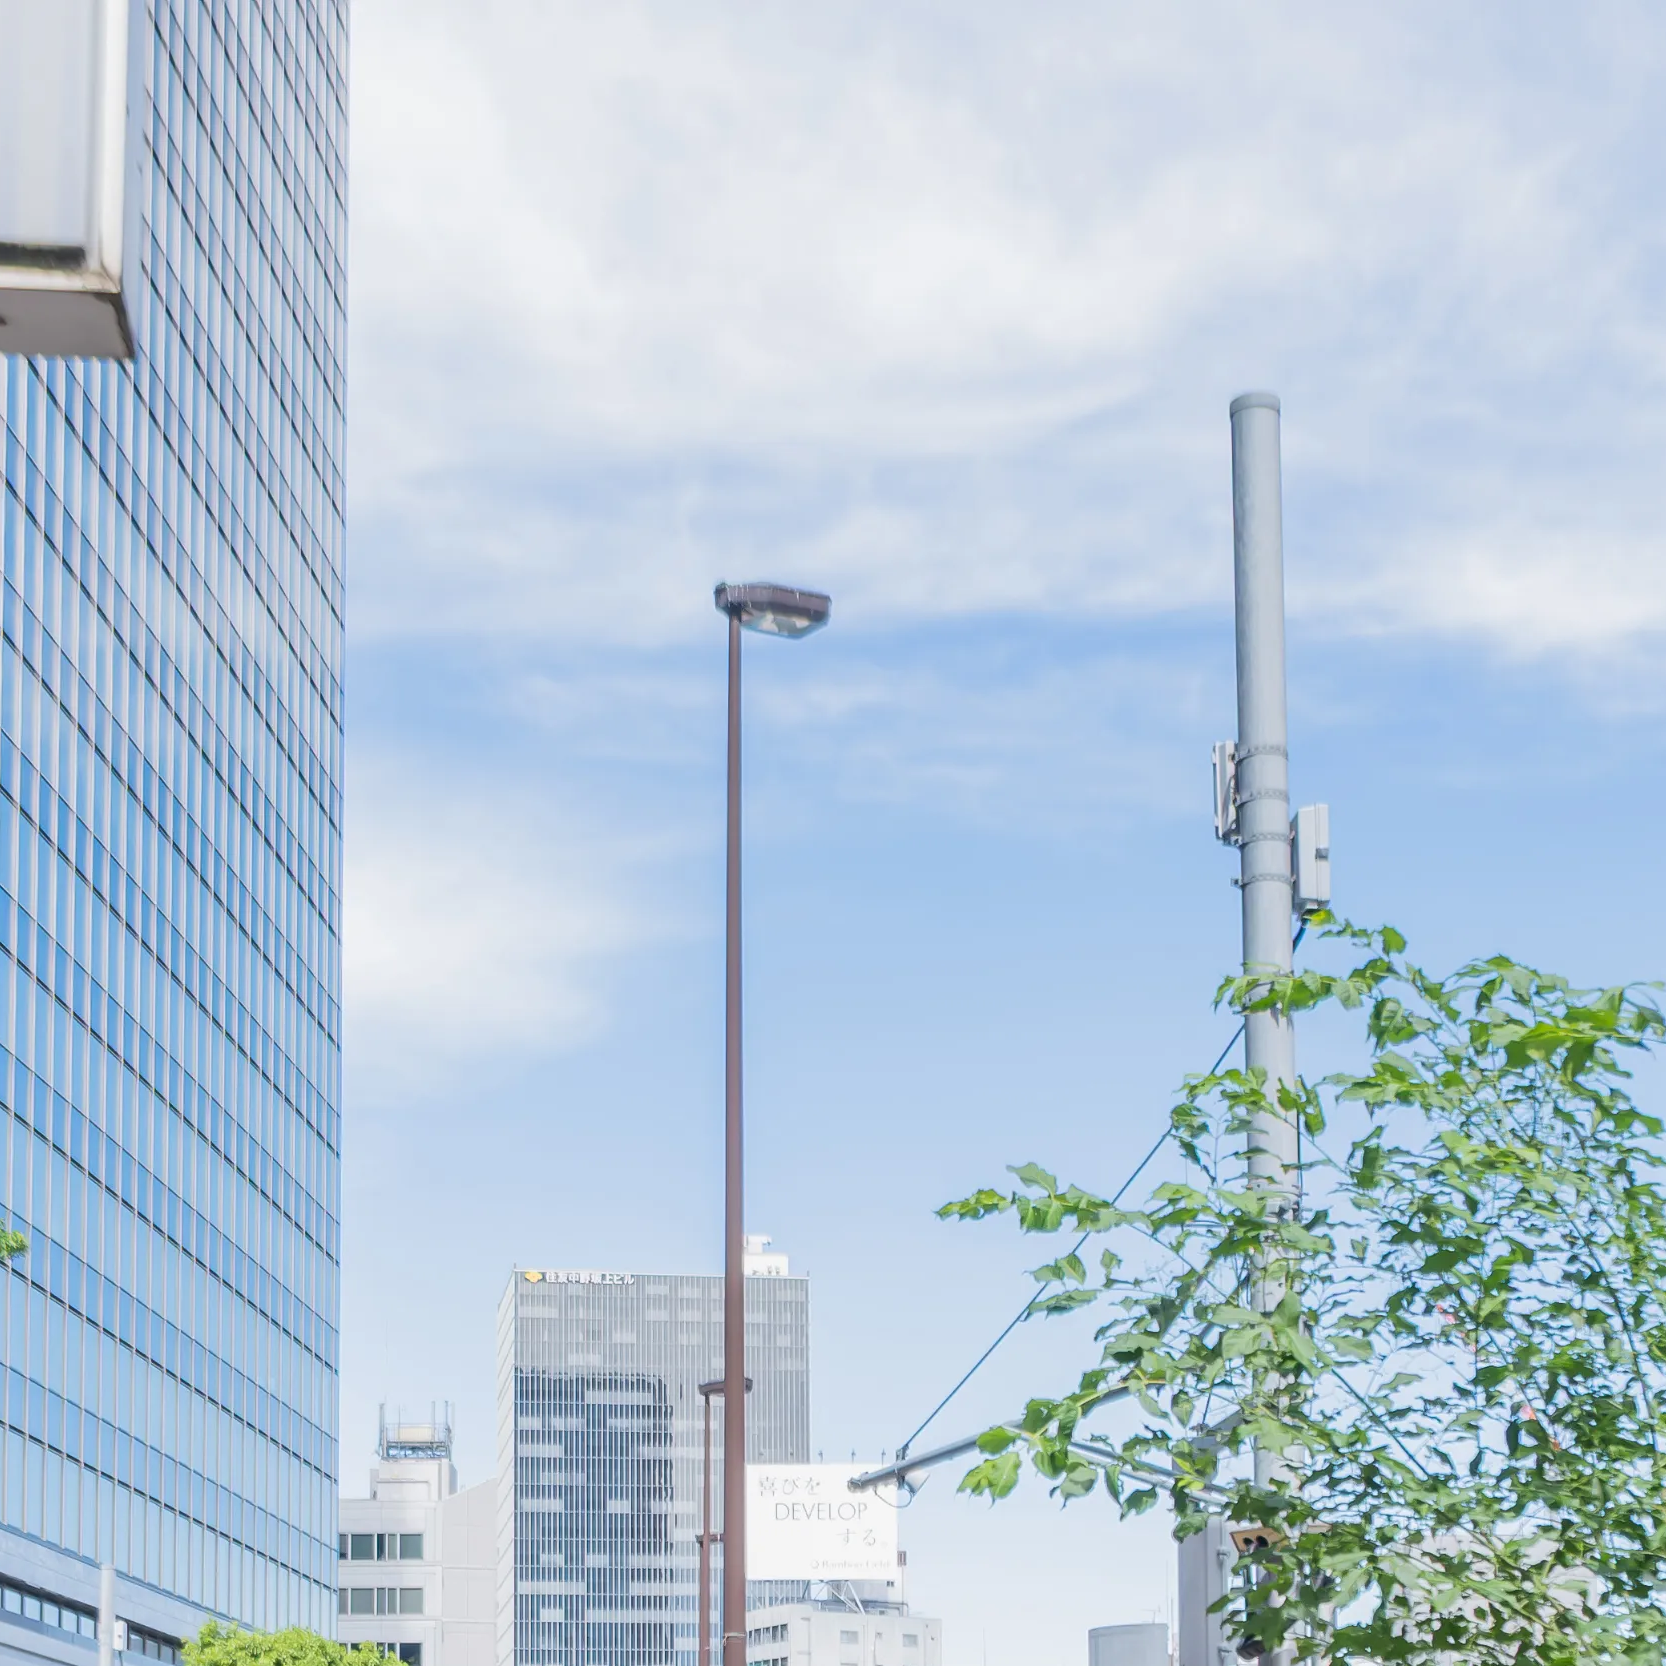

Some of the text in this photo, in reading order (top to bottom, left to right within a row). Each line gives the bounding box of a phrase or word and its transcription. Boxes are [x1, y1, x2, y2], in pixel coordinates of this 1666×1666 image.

[759, 1476, 821, 1497] 喜びを
[775, 1502, 868, 1521] DEVELOP
